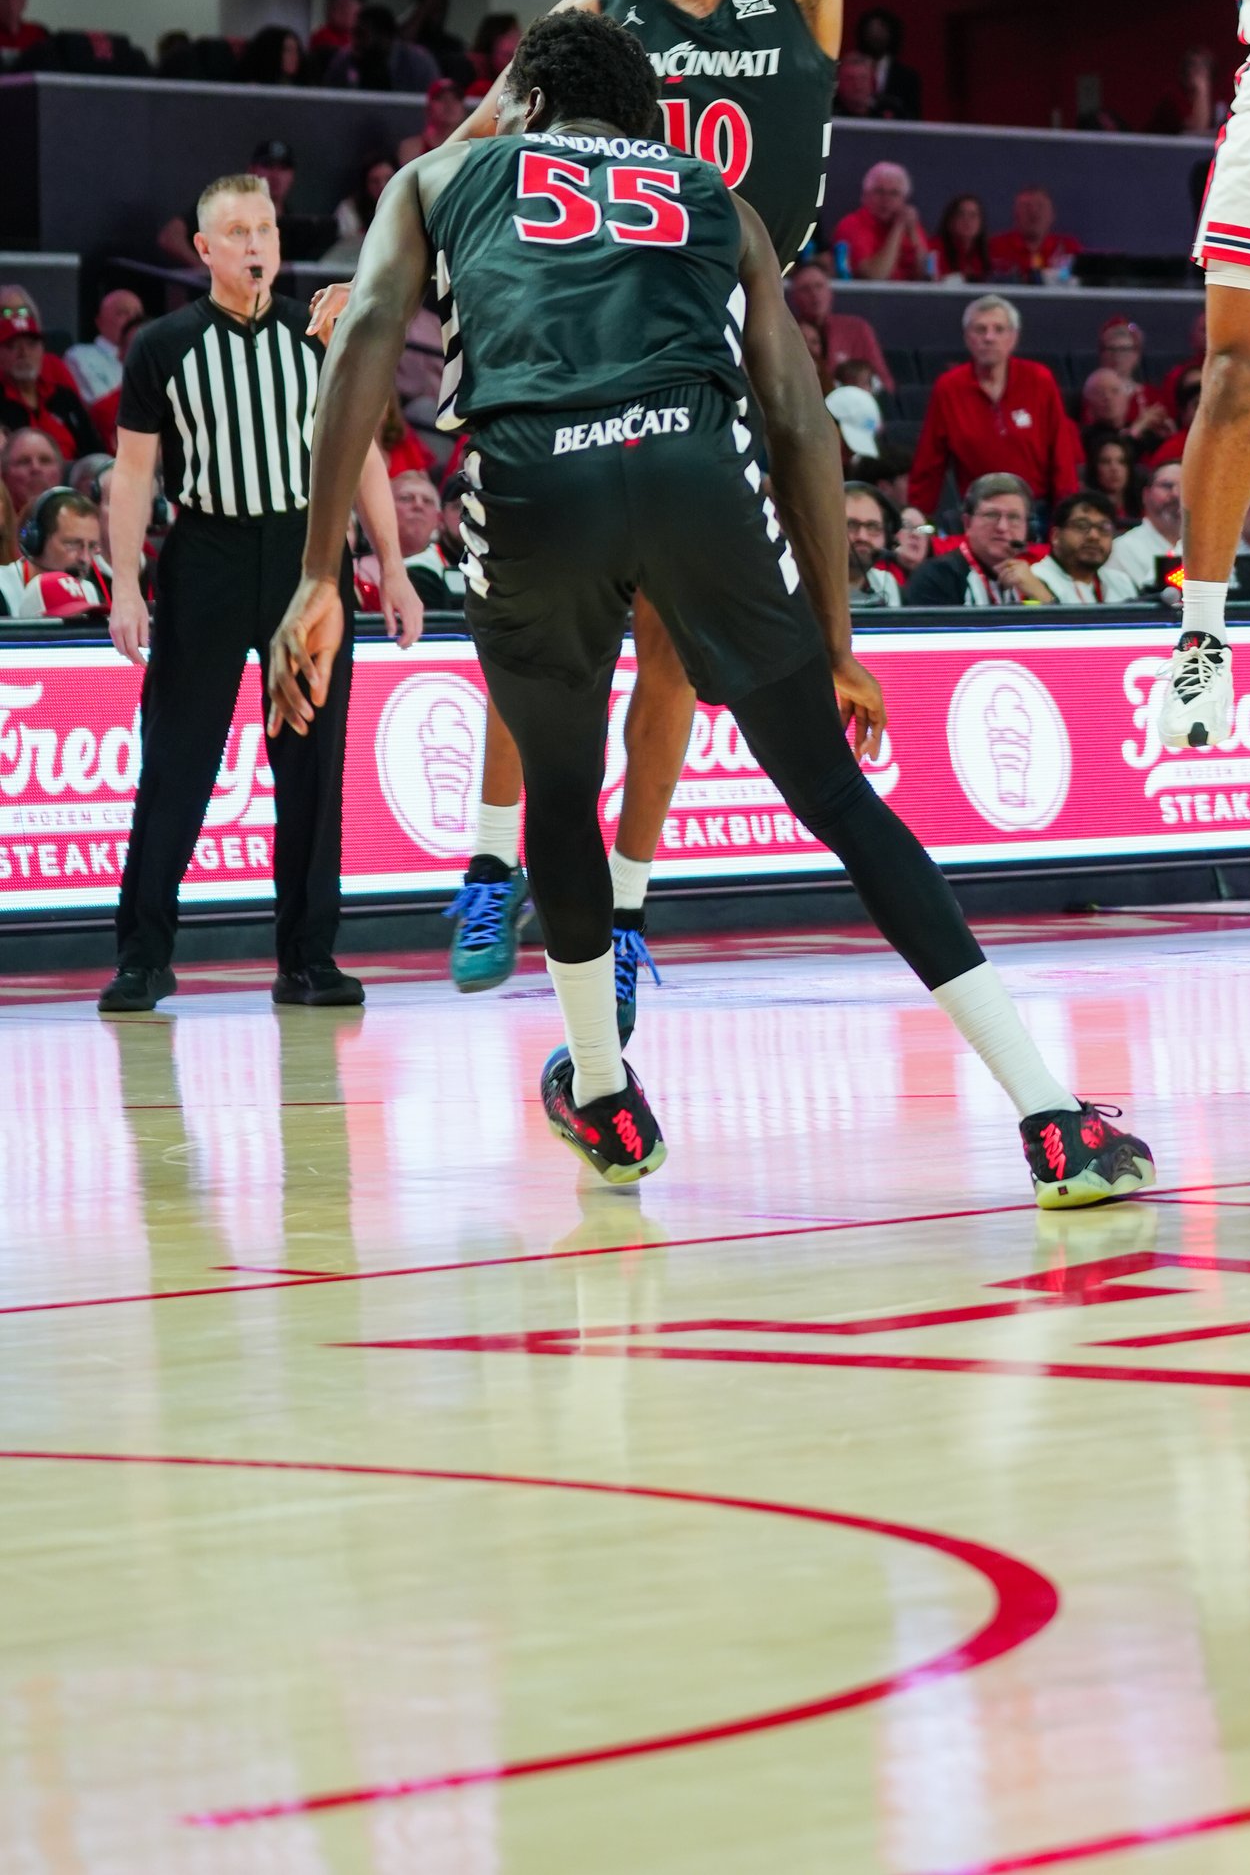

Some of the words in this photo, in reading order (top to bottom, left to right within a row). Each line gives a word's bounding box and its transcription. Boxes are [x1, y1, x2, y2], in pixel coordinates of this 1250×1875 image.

[645, 39, 782, 78] NCINNATI
[656, 98, 753, 191] 10
[512, 149, 690, 247] 55
[552, 403, 691, 456] BEARCATS
